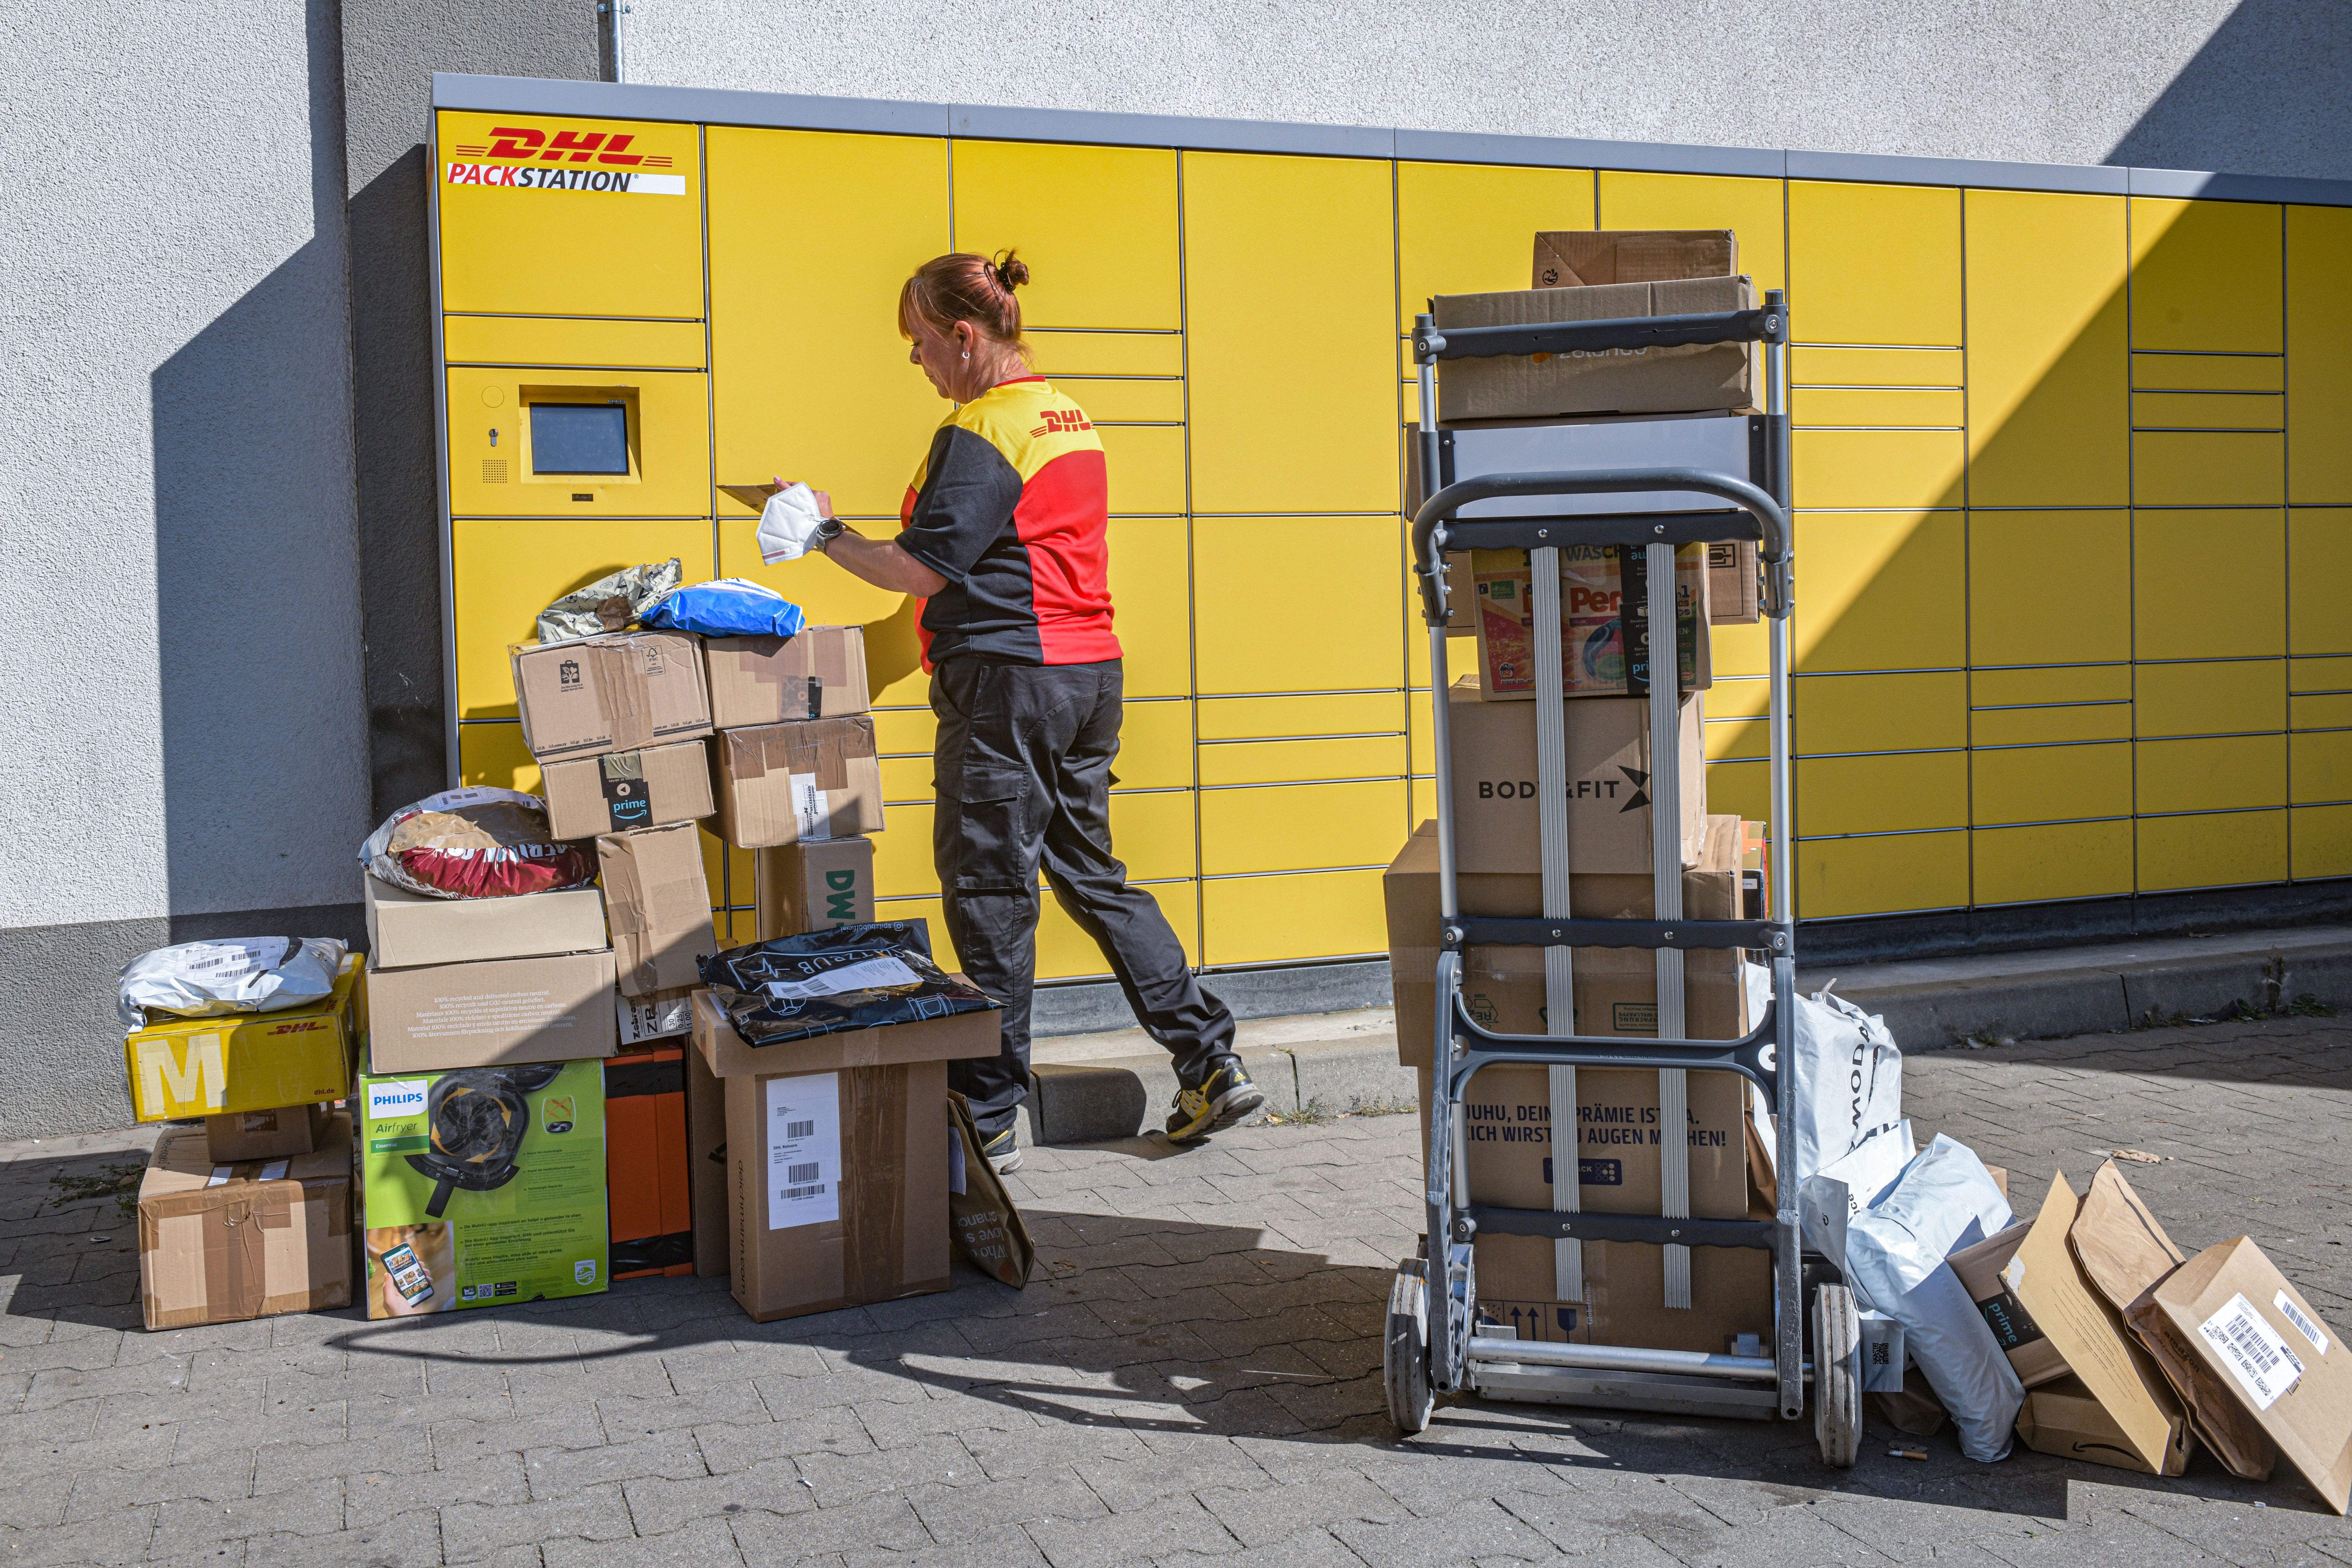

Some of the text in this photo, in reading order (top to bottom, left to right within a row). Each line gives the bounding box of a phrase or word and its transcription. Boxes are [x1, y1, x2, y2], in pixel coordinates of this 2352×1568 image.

[486, 127, 644, 165] DHL
[1040, 410, 1091, 433] DHL
[1479, 781, 1619, 799] BODFIT
[613, 799, 646, 813] prime
[826, 869, 856, 927] DW
[840, 923, 892, 932] spitzbubofficial
[276, 1022, 319, 1034] DHL
[668, 1018, 675, 1027] 30
[136, 1033, 227, 1116] M
[374, 1093, 423, 1105] PHILIPS
[1517, 1105, 1552, 1122] DEIN
[376, 1122, 417, 1133] Airfryer
[1587, 1128, 1643, 1145] AUGEN
[1649, 1129, 1726, 1147] MHEN!
[978, 1227, 1005, 1241] love
[980, 1244, 1008, 1259] Who
[1584, 1281, 1593, 1325] Globetrotter
[1988, 1303, 2017, 1343] prime
[2164, 1331, 2200, 1373] amazon
[2285, 1347, 2301, 1367] DHL
[2285, 1352, 2295, 1365] PRIO
